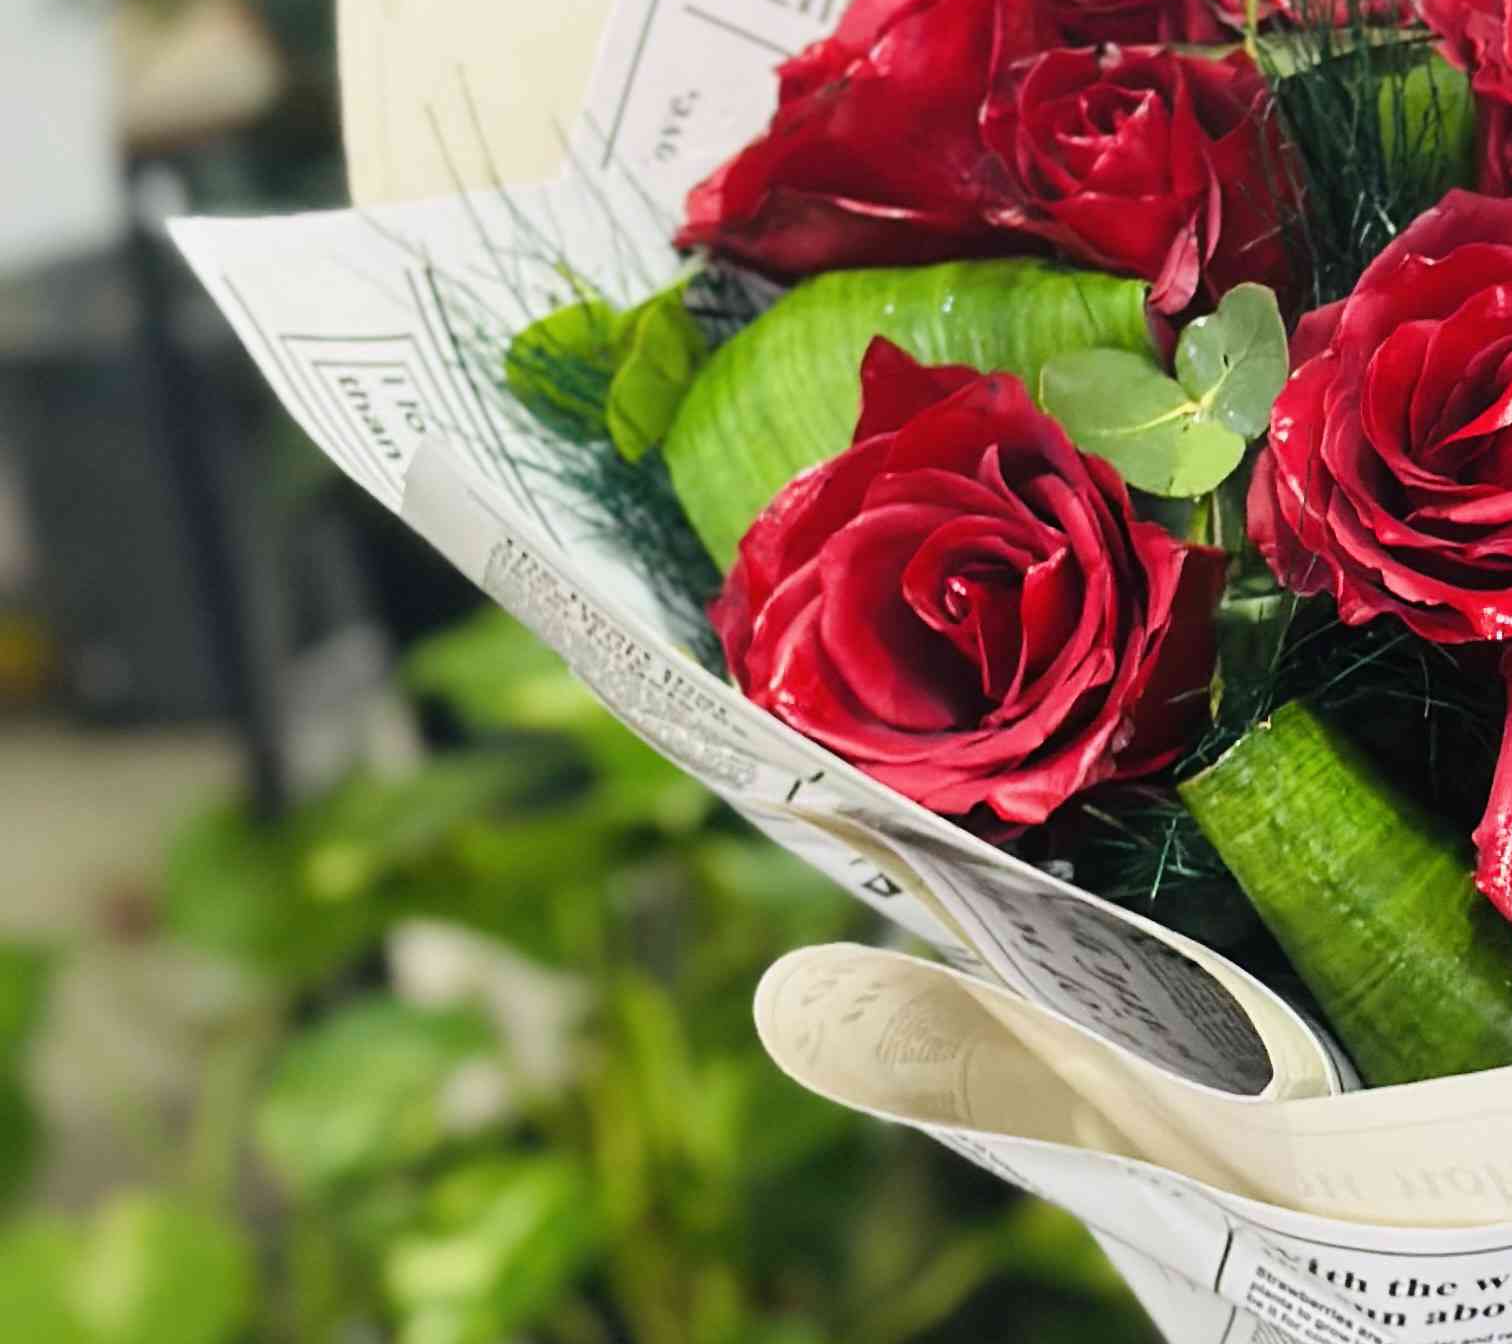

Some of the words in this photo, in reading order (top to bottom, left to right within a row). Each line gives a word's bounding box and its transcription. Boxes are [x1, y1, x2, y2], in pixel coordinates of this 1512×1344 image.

[1249, 1281, 1294, 1312] plants
[1313, 1317, 1351, 1344] grow
[1255, 1265, 1353, 1330] Strawberries
[1387, 1276, 1459, 1298] the
